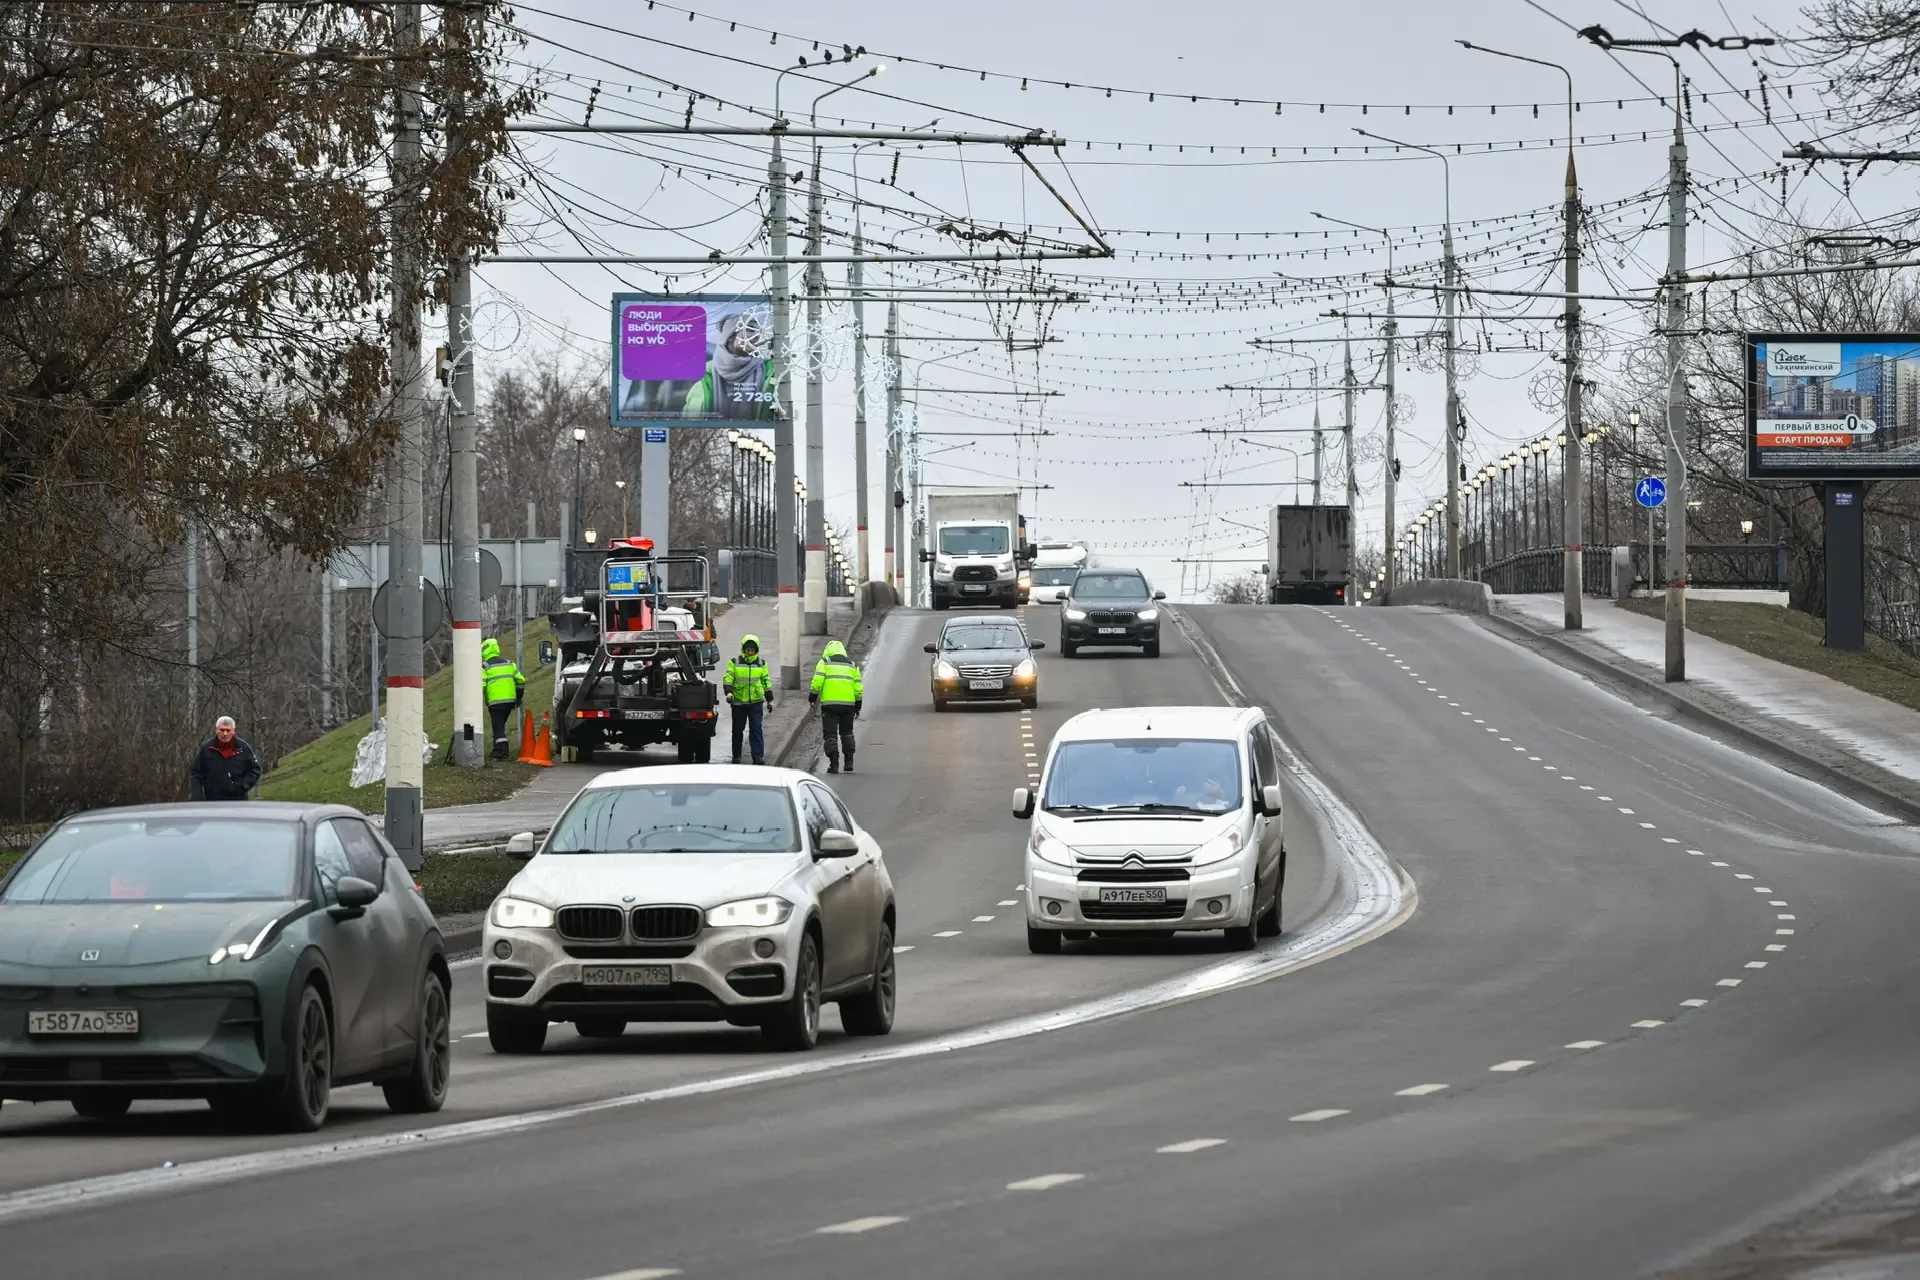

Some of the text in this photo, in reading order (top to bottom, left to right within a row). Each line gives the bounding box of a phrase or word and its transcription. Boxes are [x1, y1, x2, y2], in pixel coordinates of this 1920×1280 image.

[628, 310, 662, 321] люди
[628, 322, 693, 334] выбирают
[628, 334, 666, 345] на wb
[1775, 421, 1812, 431] ПЕРВЫЙ
[1814, 423, 1845, 431] ВЗНОС
[1775, 435, 1844, 445] СТАРТ ПРОДАЖ
